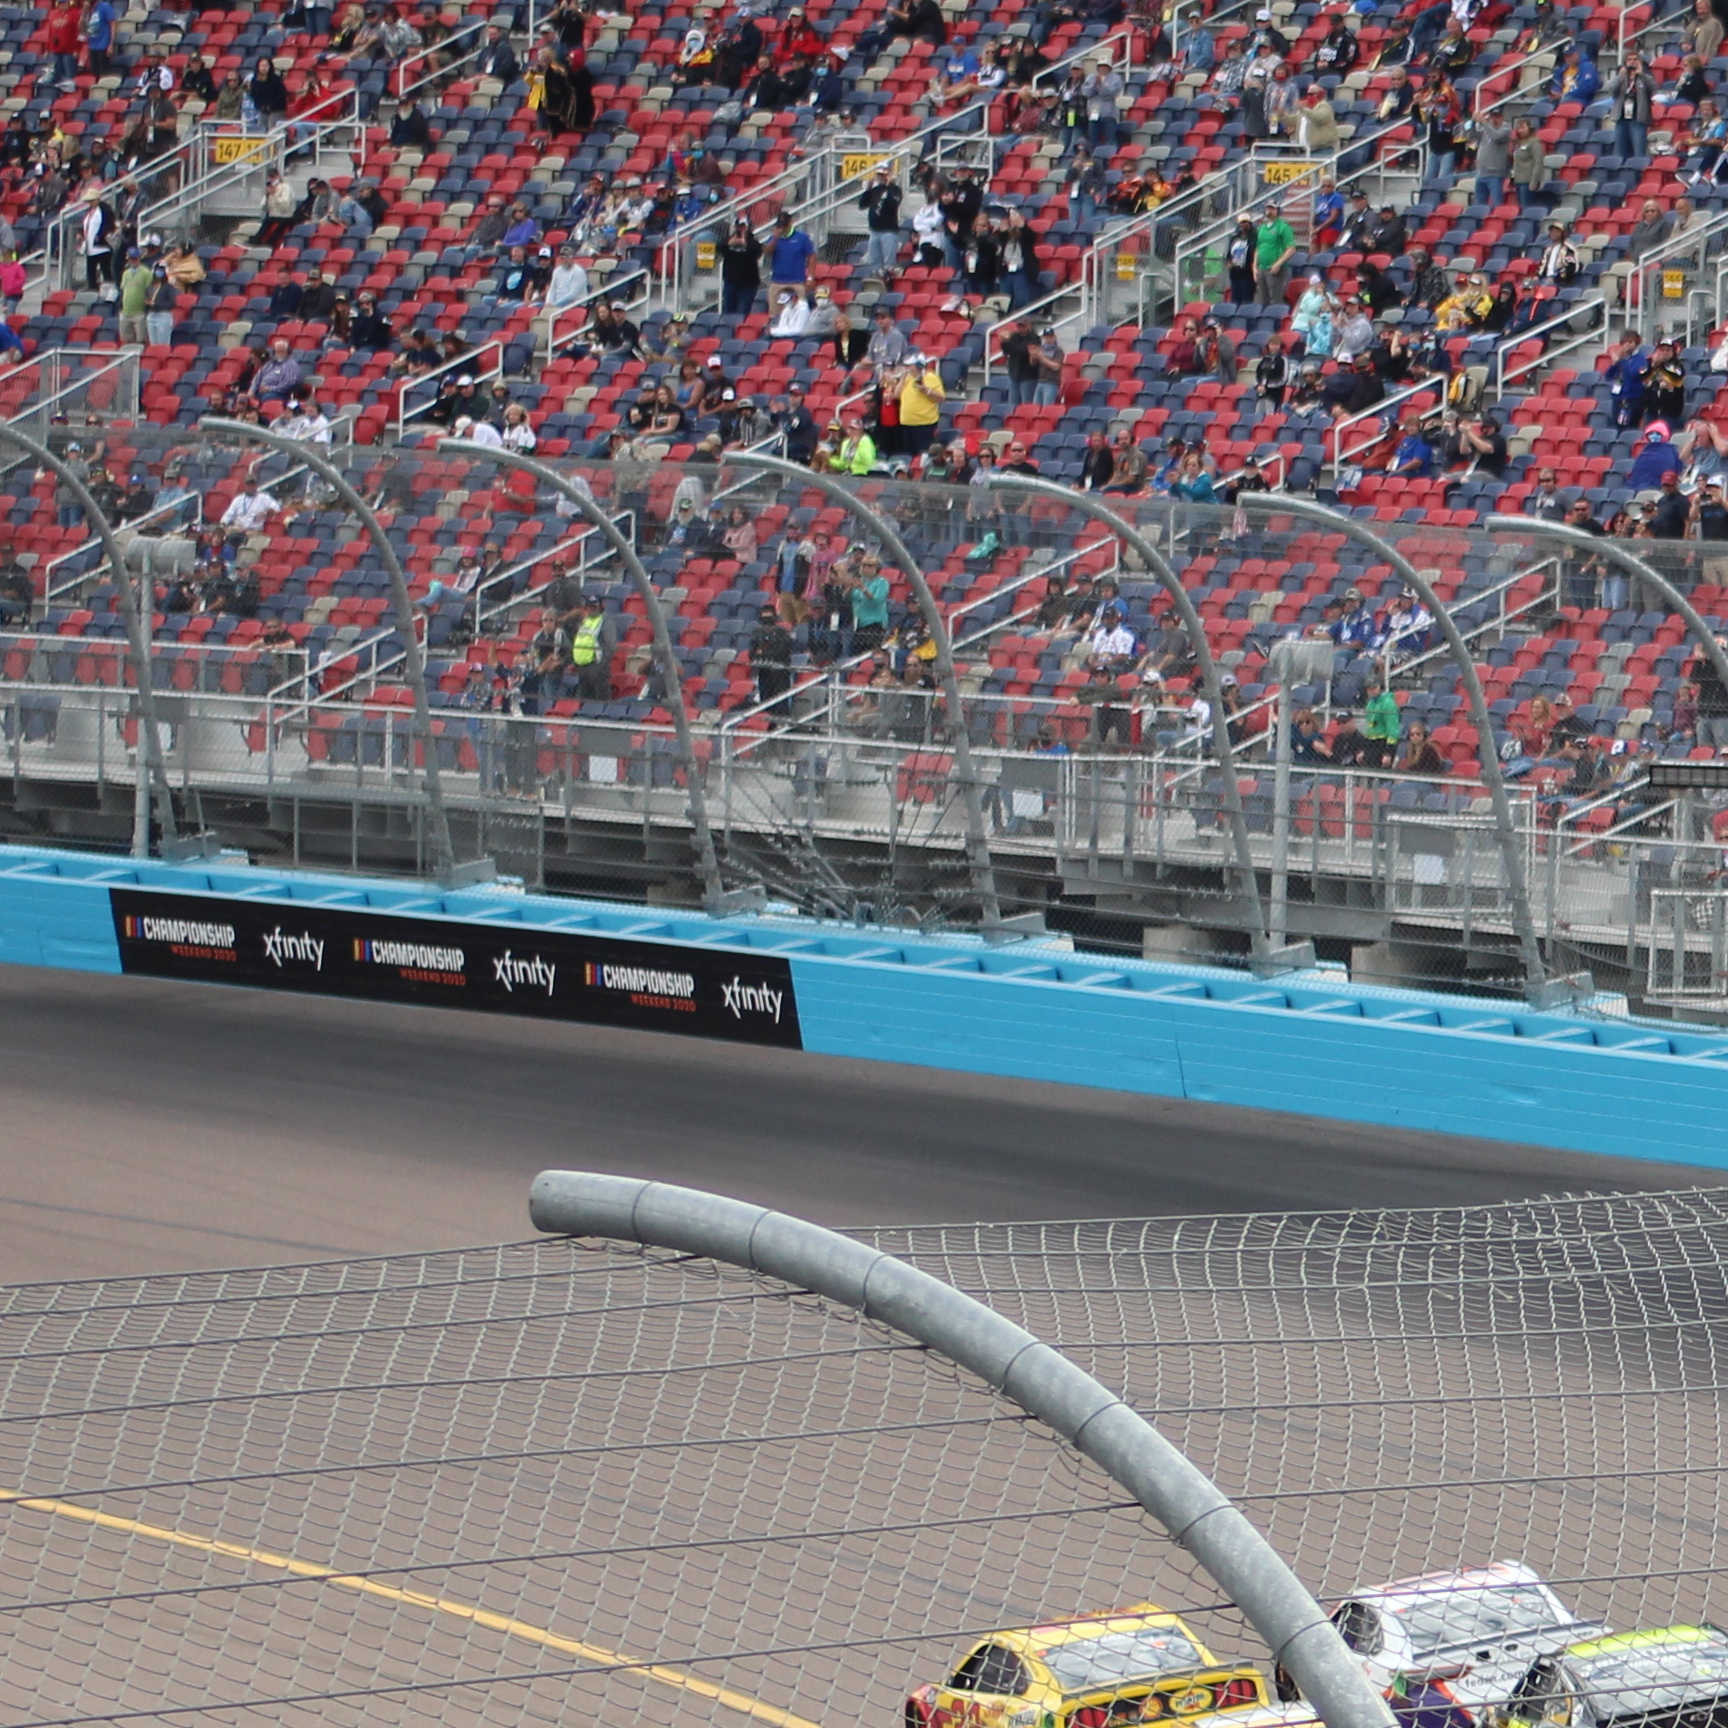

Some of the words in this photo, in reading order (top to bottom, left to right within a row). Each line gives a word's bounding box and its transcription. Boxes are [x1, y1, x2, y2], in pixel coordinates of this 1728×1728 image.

[143, 916, 236, 948] CHAMPIONSHIP
[213, 948, 237, 962] 2020
[263, 926, 325, 972] xfinity
[371, 939, 465, 972] CHAMPIONSHIP
[442, 972, 466, 986] 2020
[492, 949, 556, 997] xfinity
[603, 964, 695, 998] CHAMPIONSHIP
[672, 998, 696, 1012] 2020
[721, 975, 783, 1024] xfinity
